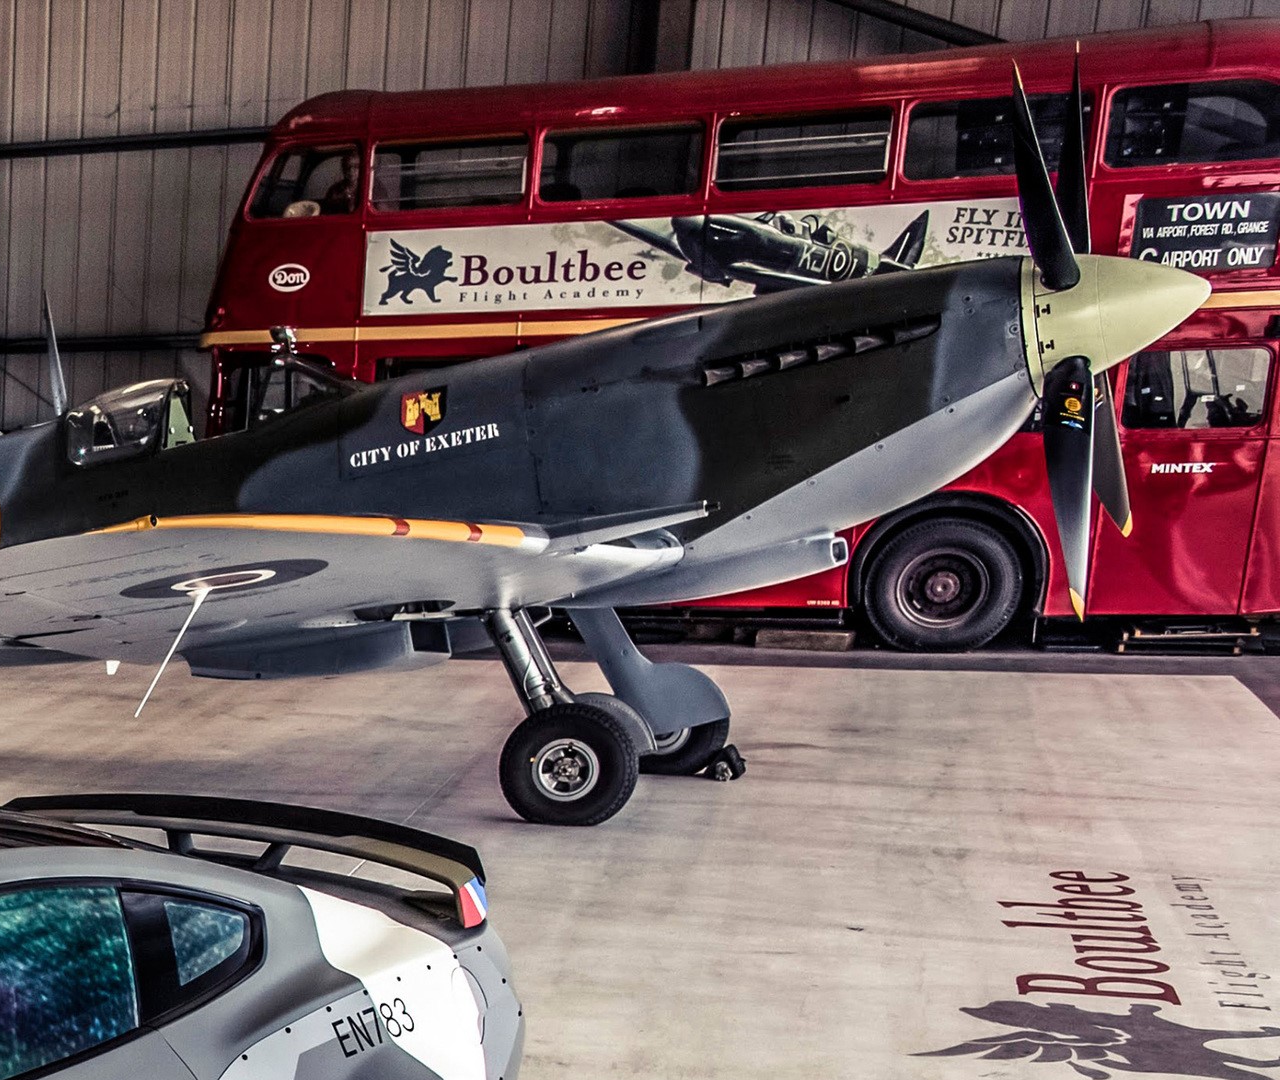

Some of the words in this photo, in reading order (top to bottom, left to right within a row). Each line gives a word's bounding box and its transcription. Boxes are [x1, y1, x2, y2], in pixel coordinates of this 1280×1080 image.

[953, 207, 999, 225] FLY
[1167, 200, 1251, 222] TOWN
[946, 226, 1030, 248] SPITFI
[1142, 227, 1154, 239] VIA
[1190, 223, 1220, 236] FOREST
[1237, 221, 1270, 233] GRANGE
[459, 249, 647, 286] Boultbee
[1160, 249, 1222, 268] AIRPORT
[1227, 246, 1265, 267] ONLY
[274, 270, 307, 285] Don
[459, 290, 528, 304] Flight
[544, 287, 644, 300] Academy
[350, 446, 392, 468] CITY
[396, 440, 420, 458] OF
[425, 423, 500, 453] EXETER
[1151, 462, 1216, 474] MINTEX
[1170, 874, 1231, 941] Academy
[996, 870, 1182, 1006] Boultbee
[1199, 950, 1272, 1011] Flight
[331, 997, 414, 1058] EN783
